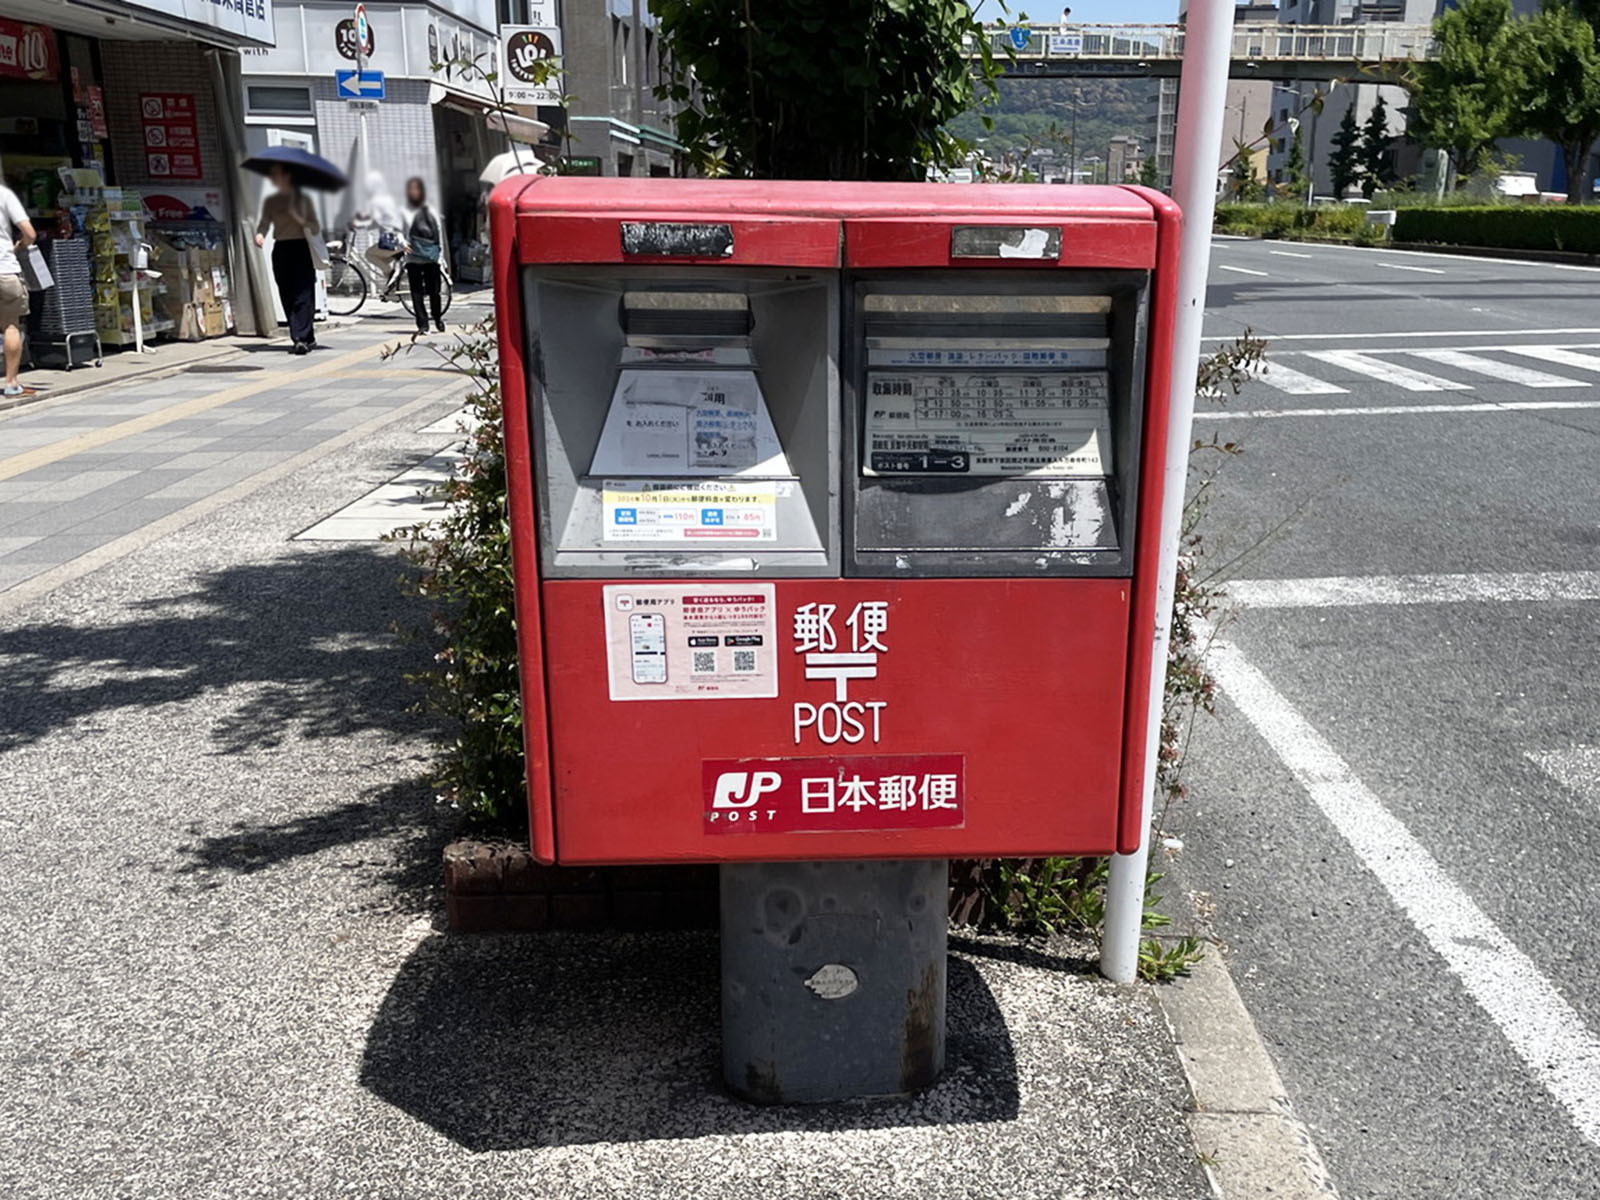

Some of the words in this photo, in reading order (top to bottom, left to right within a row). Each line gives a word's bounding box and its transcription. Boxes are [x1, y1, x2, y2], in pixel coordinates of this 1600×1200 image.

[243, 48, 269, 56] with
[793, 601, 889, 653] 郵便
[794, 702, 887, 743] POST
[801, 773, 958, 813] 日本郵便
[709, 810, 777, 822] POST
